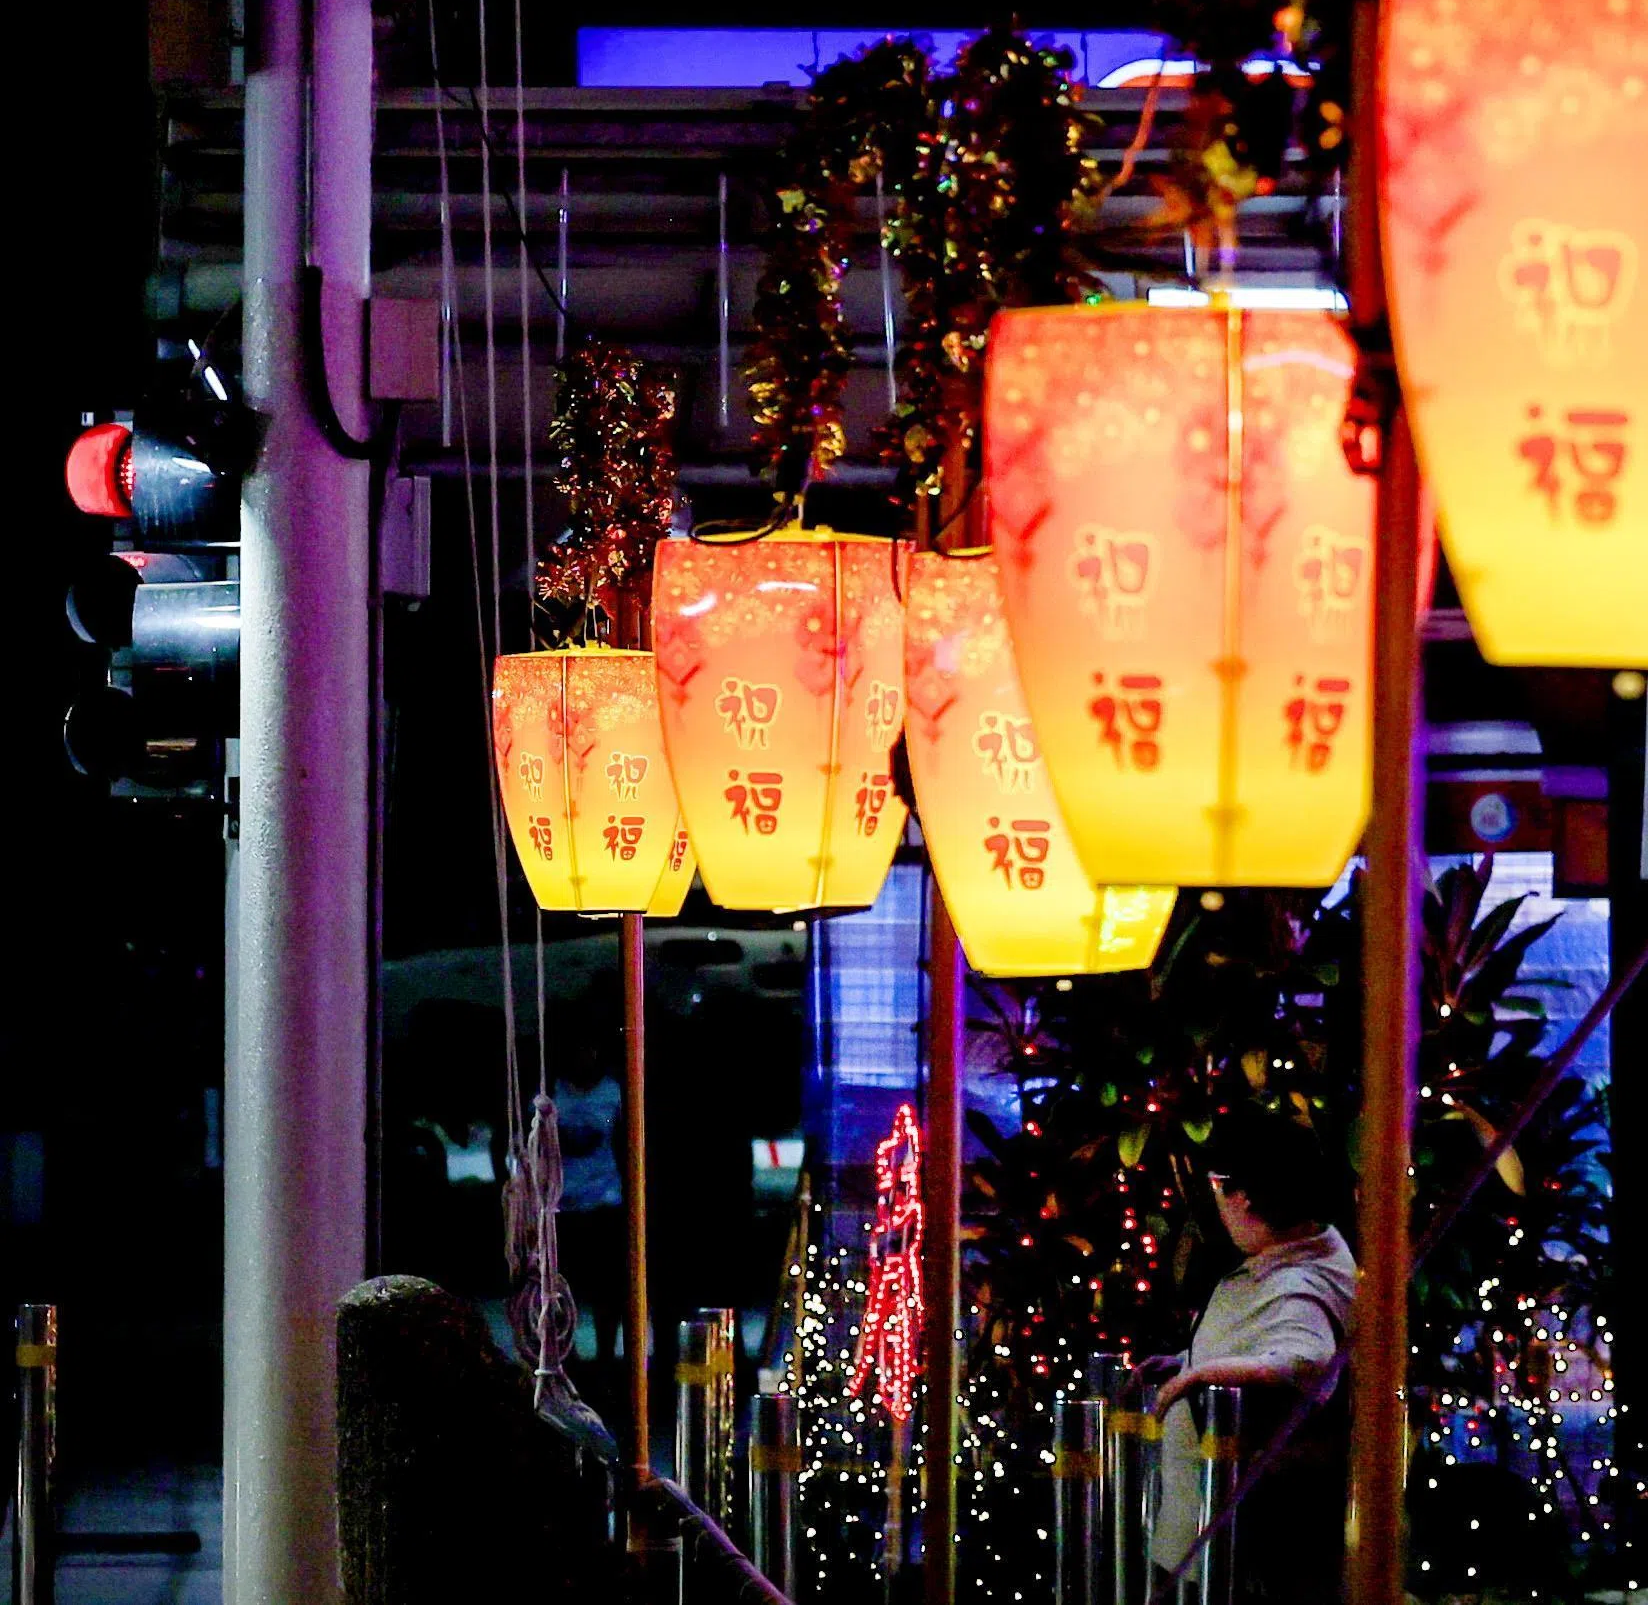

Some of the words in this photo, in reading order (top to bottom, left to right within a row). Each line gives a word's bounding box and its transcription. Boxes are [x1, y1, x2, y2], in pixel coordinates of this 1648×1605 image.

[1076, 530, 1166, 772] 祝福
[519, 752, 553, 861] 祝福
[603, 751, 649, 863] 祝福
[716, 677, 784, 836] 祝福
[854, 680, 903, 837] 祝福
[975, 713, 1052, 891] 祝福
[668, 830, 689, 872] 福
